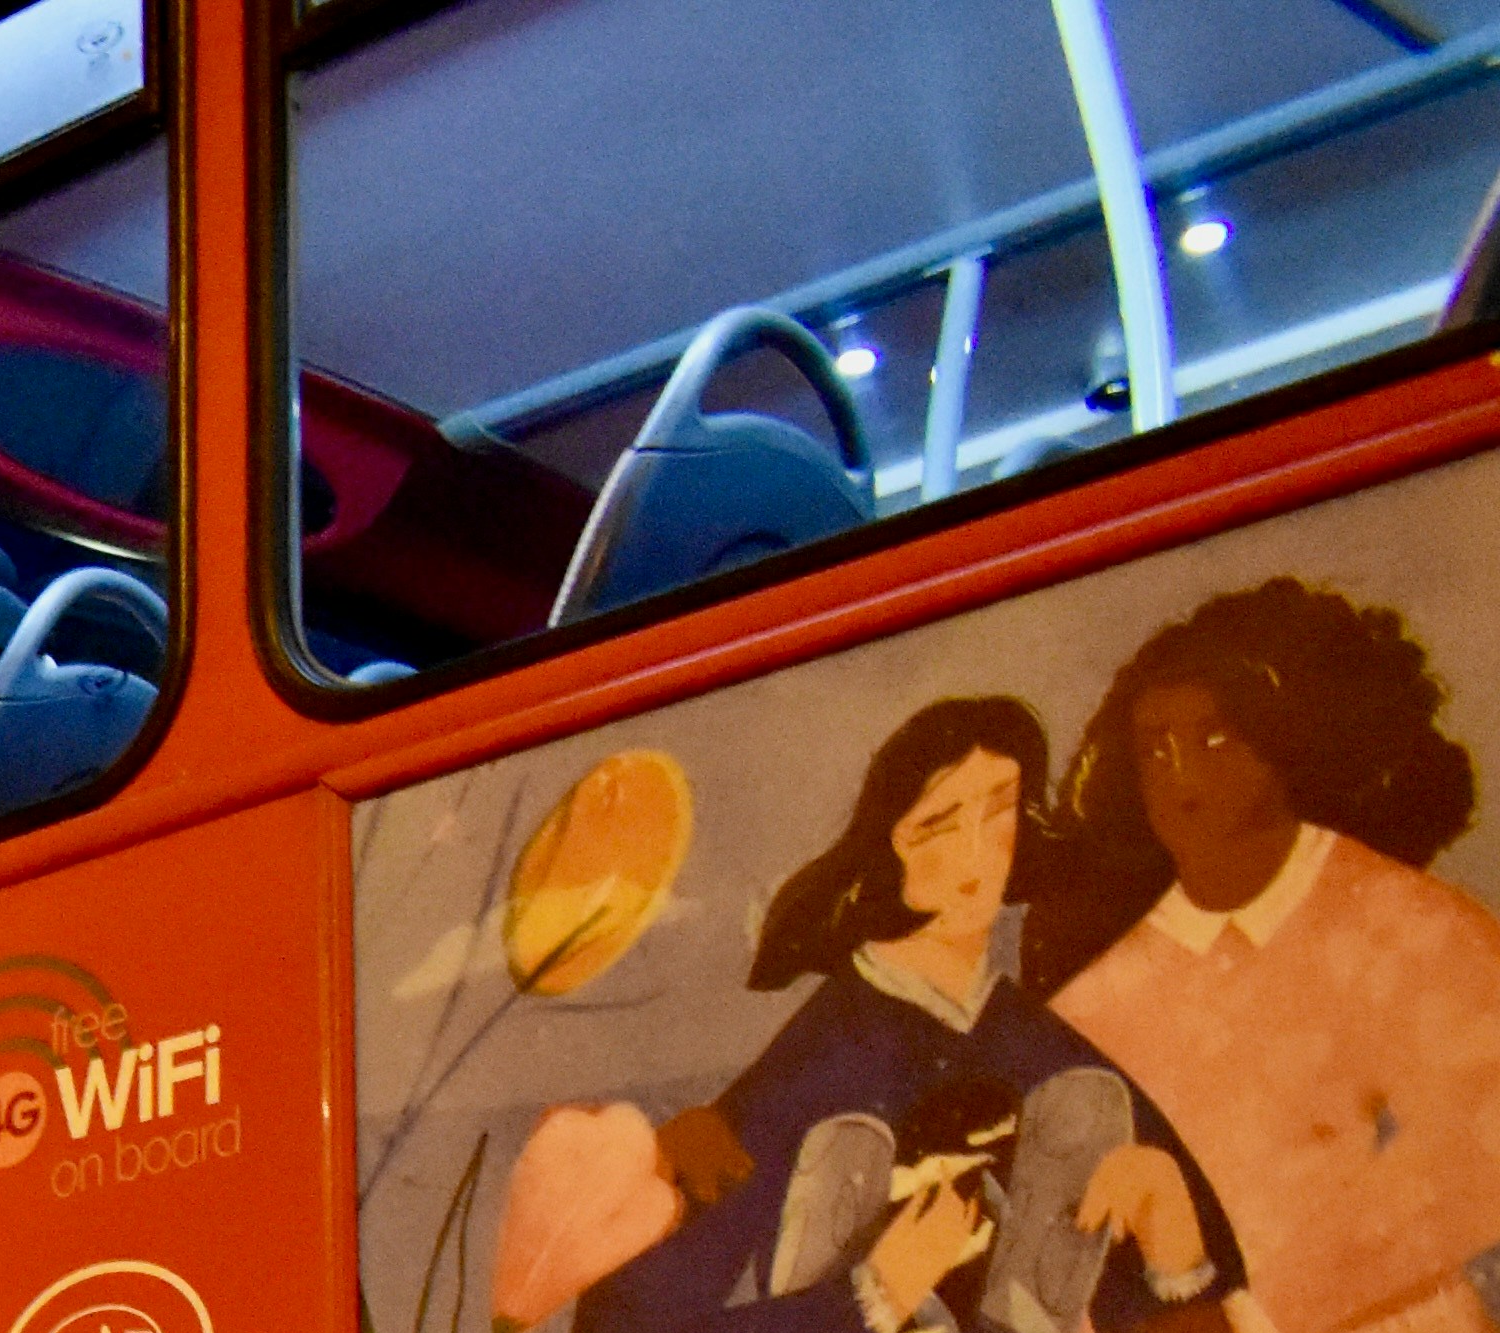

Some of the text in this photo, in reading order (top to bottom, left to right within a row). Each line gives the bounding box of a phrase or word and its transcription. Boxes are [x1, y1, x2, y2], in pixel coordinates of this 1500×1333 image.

[51, 1003, 128, 1055] free
[55, 1023, 221, 1140] WiFi
[51, 1103, 242, 1198] on board
